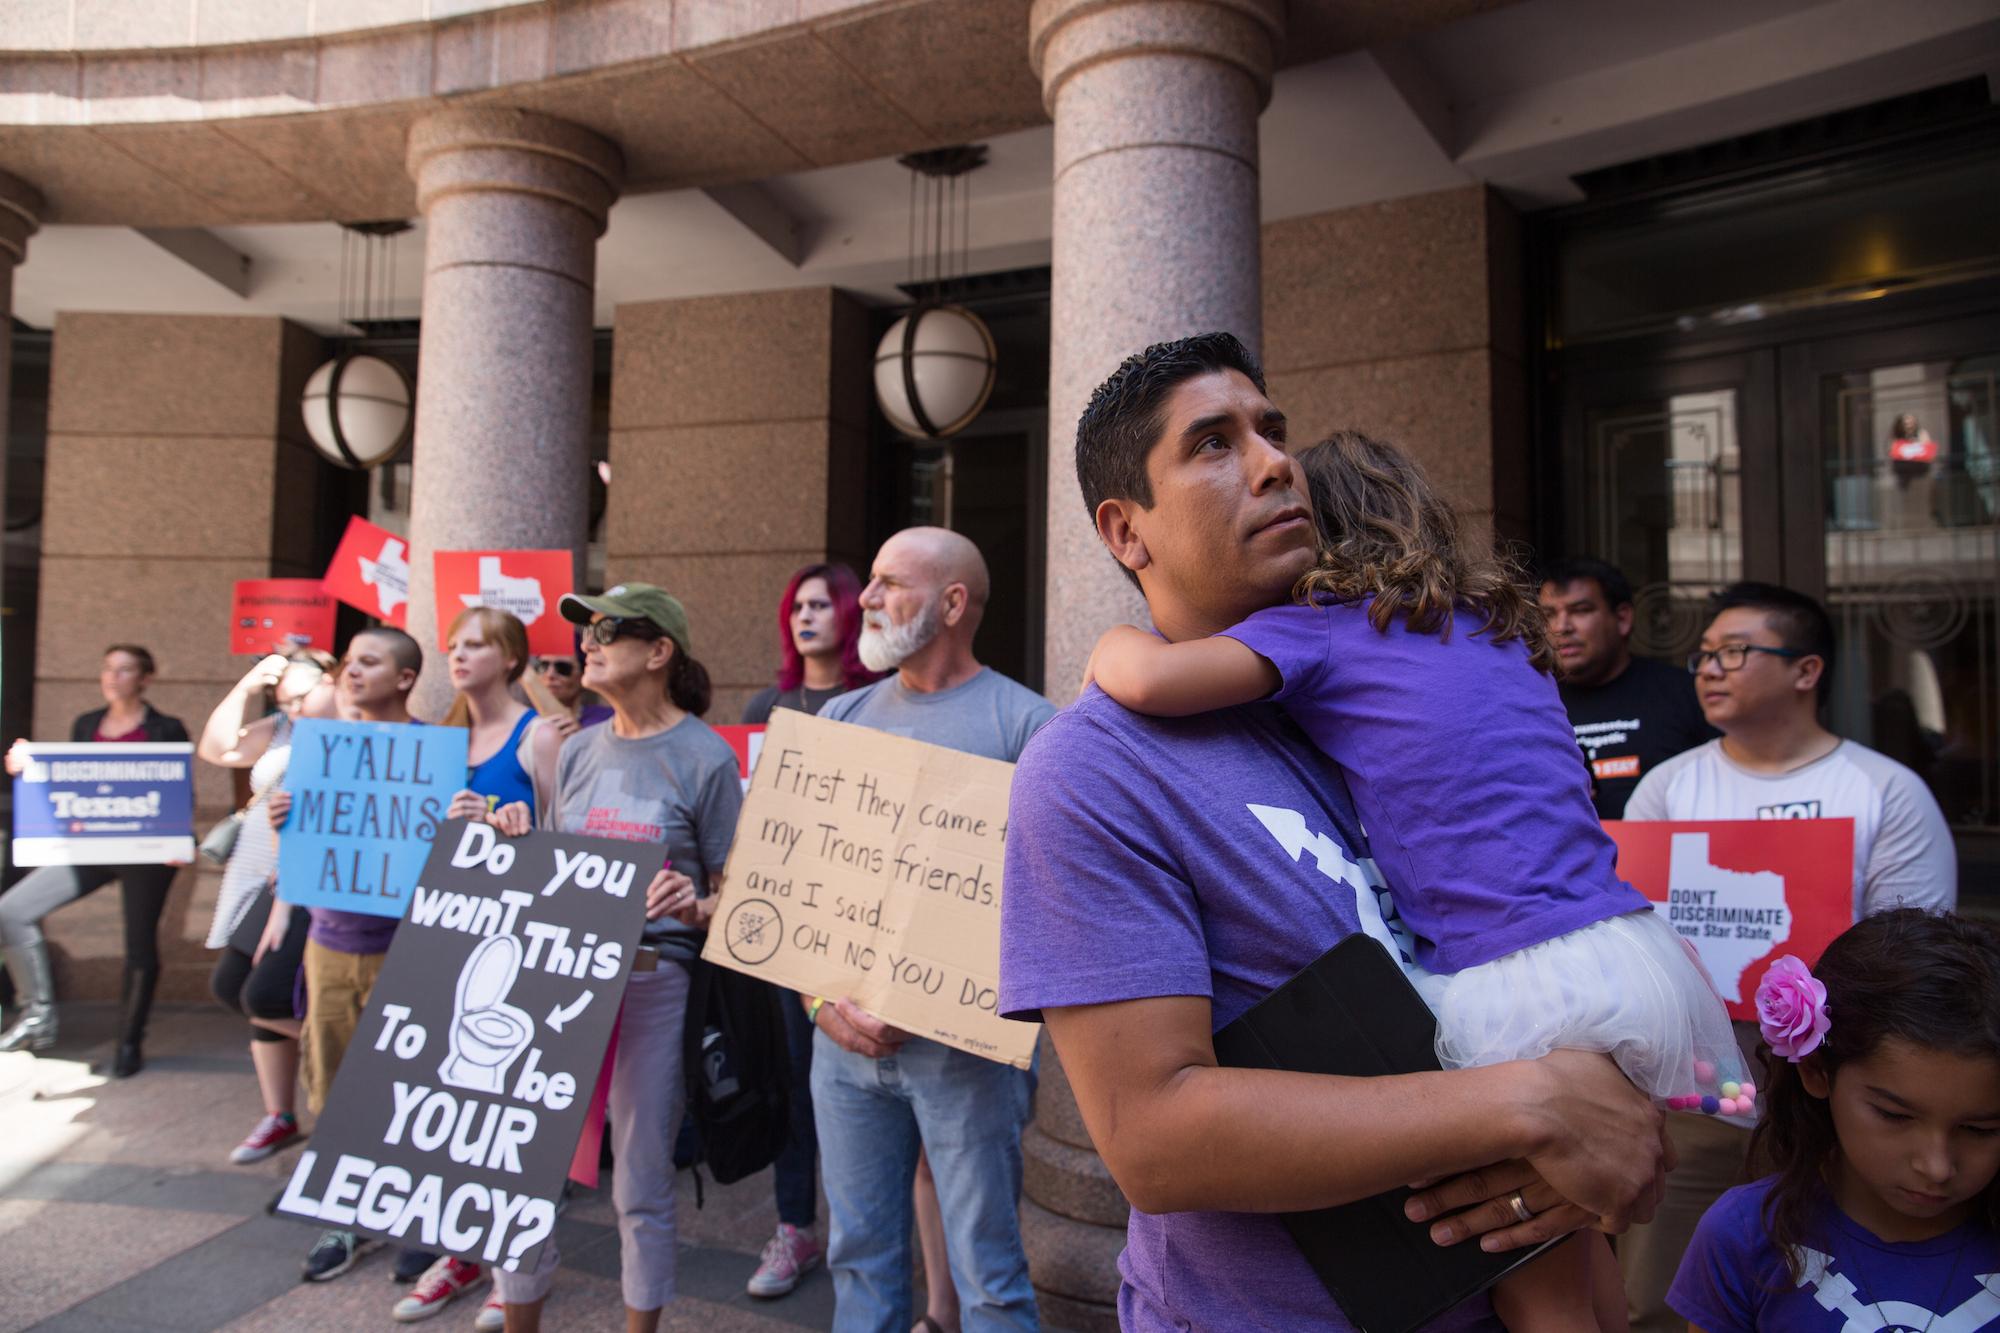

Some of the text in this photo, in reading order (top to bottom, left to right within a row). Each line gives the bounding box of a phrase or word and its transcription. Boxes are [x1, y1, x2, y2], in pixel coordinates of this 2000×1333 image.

[1573, 718, 1640, 735] cumented
[51, 761, 186, 782] DISCRIMINATION
[320, 733, 433, 785] Y'ALL
[1602, 758, 1639, 776] STAY
[49, 790, 162, 819] Texas!
[298, 788, 443, 843] MEANS
[773, 748, 845, 805] First
[918, 803, 987, 838] came
[450, 821, 516, 875] Do
[584, 817, 663, 839] DISCRIMINATE
[761, 816, 803, 866] my
[817, 823, 884, 873] Trans
[318, 848, 402, 899] ALL
[1671, 889, 1717, 905] DON'T
[746, 870, 897, 935] and I said...
[1669, 906, 1784, 926] DISCRIMINATE
[523, 921, 624, 980] This
[1703, 923, 1731, 938] Star
[1735, 925, 1771, 940] State
[793, 923, 830, 956] OH
[844, 940, 876, 972] NO
[888, 953, 945, 996] YOU
[374, 1003, 577, 1111] To be
[383, 1080, 538, 1174] YOUR
[276, 1150, 557, 1273] LEGACY?
